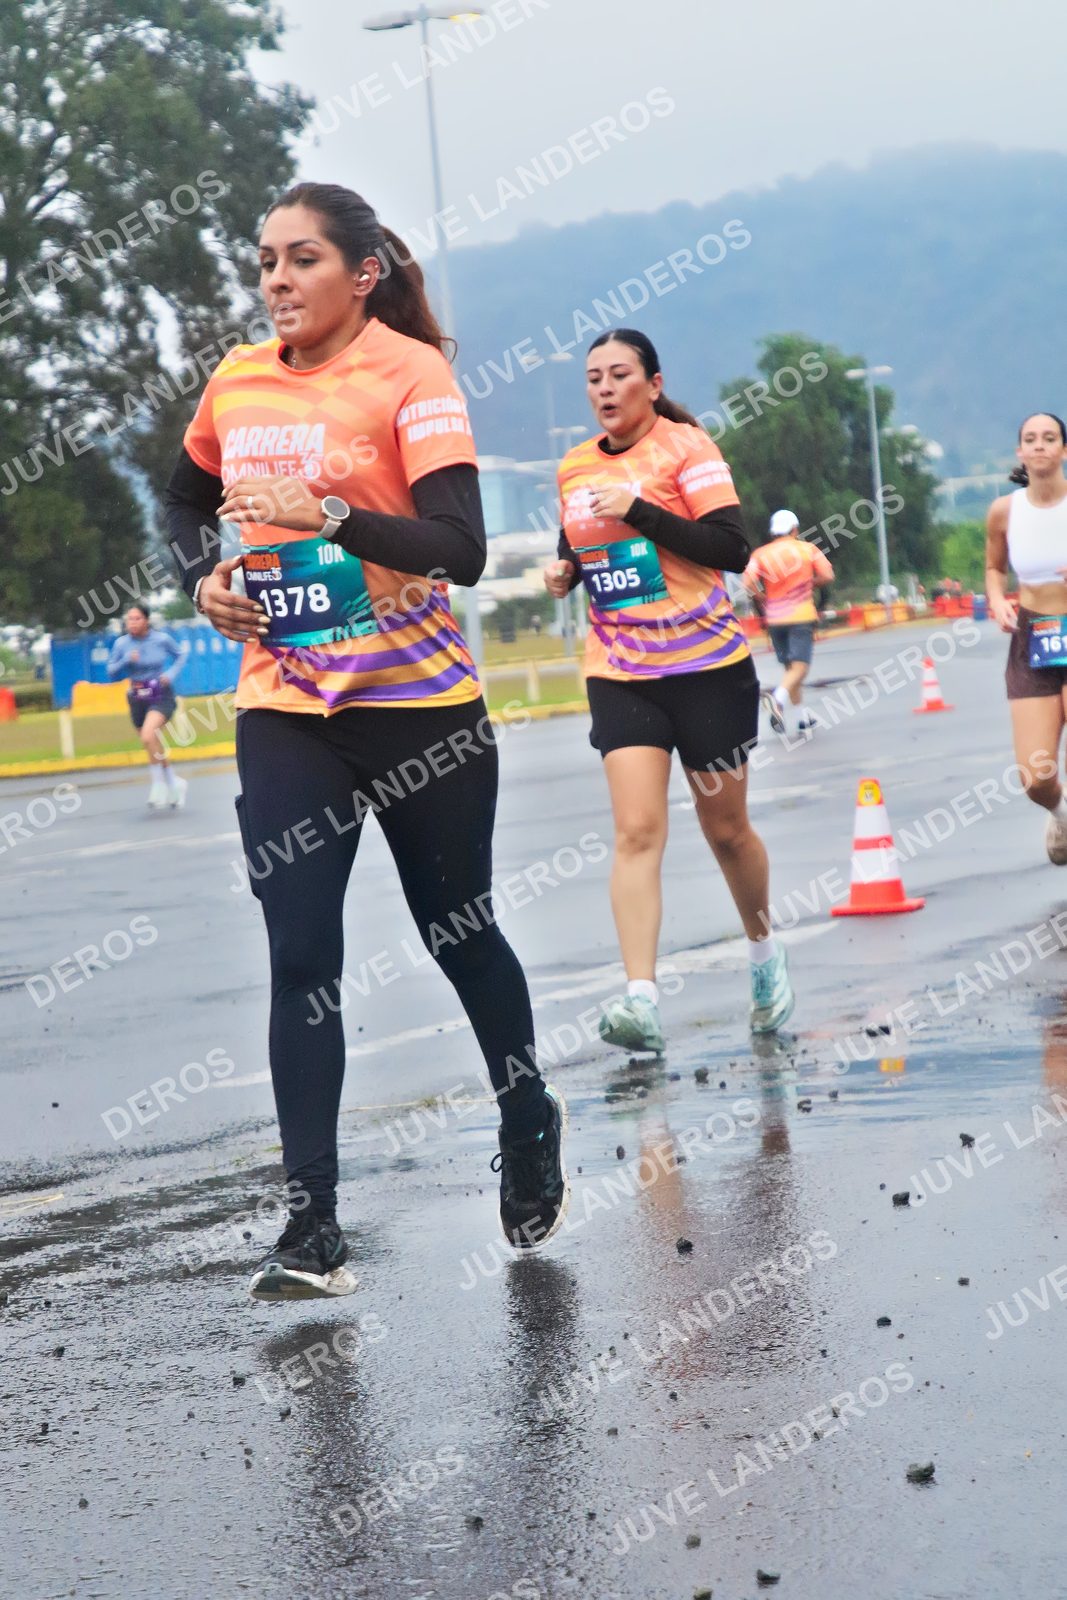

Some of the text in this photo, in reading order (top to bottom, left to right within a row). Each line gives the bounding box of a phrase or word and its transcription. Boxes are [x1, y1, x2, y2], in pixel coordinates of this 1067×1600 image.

[223, 423, 326, 460] CARRERA
[316, 543, 345, 565] 10K
[629, 542, 648, 557] 10K
[591, 567, 640, 592] 1305
[259, 583, 331, 617] 1378
